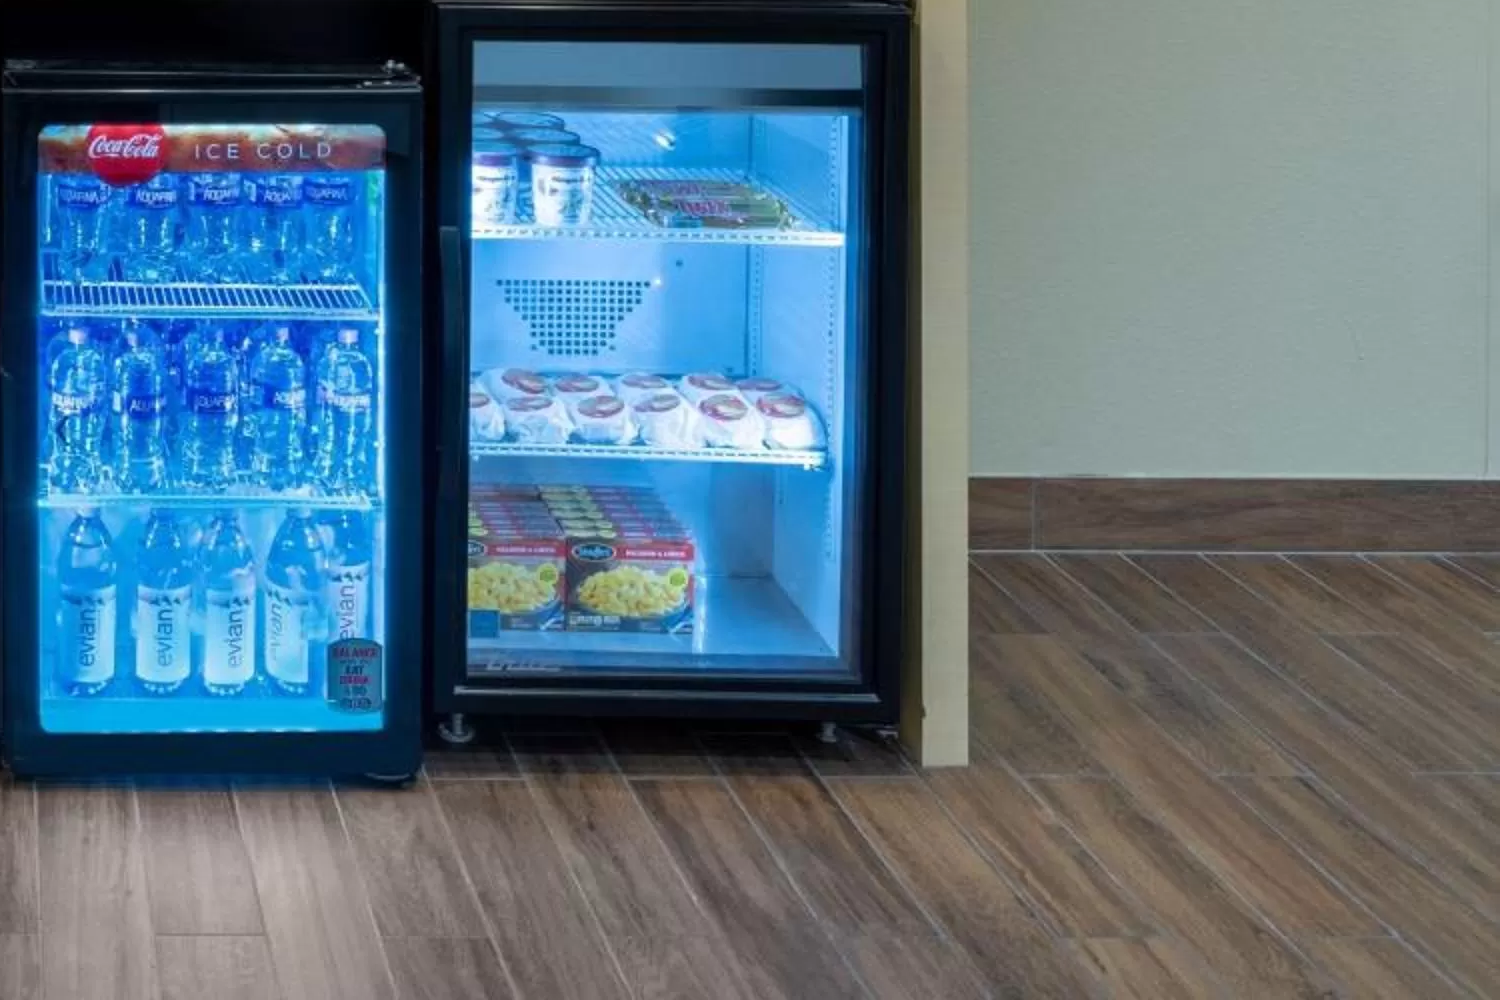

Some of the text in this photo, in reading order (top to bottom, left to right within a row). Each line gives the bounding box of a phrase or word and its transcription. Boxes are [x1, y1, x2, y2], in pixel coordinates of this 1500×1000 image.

[88, 133, 333, 160] Coca-Cola ICE COLD
[78, 606, 98, 668] evian
[157, 605, 174, 668] evian
[227, 604, 244, 669] evian
